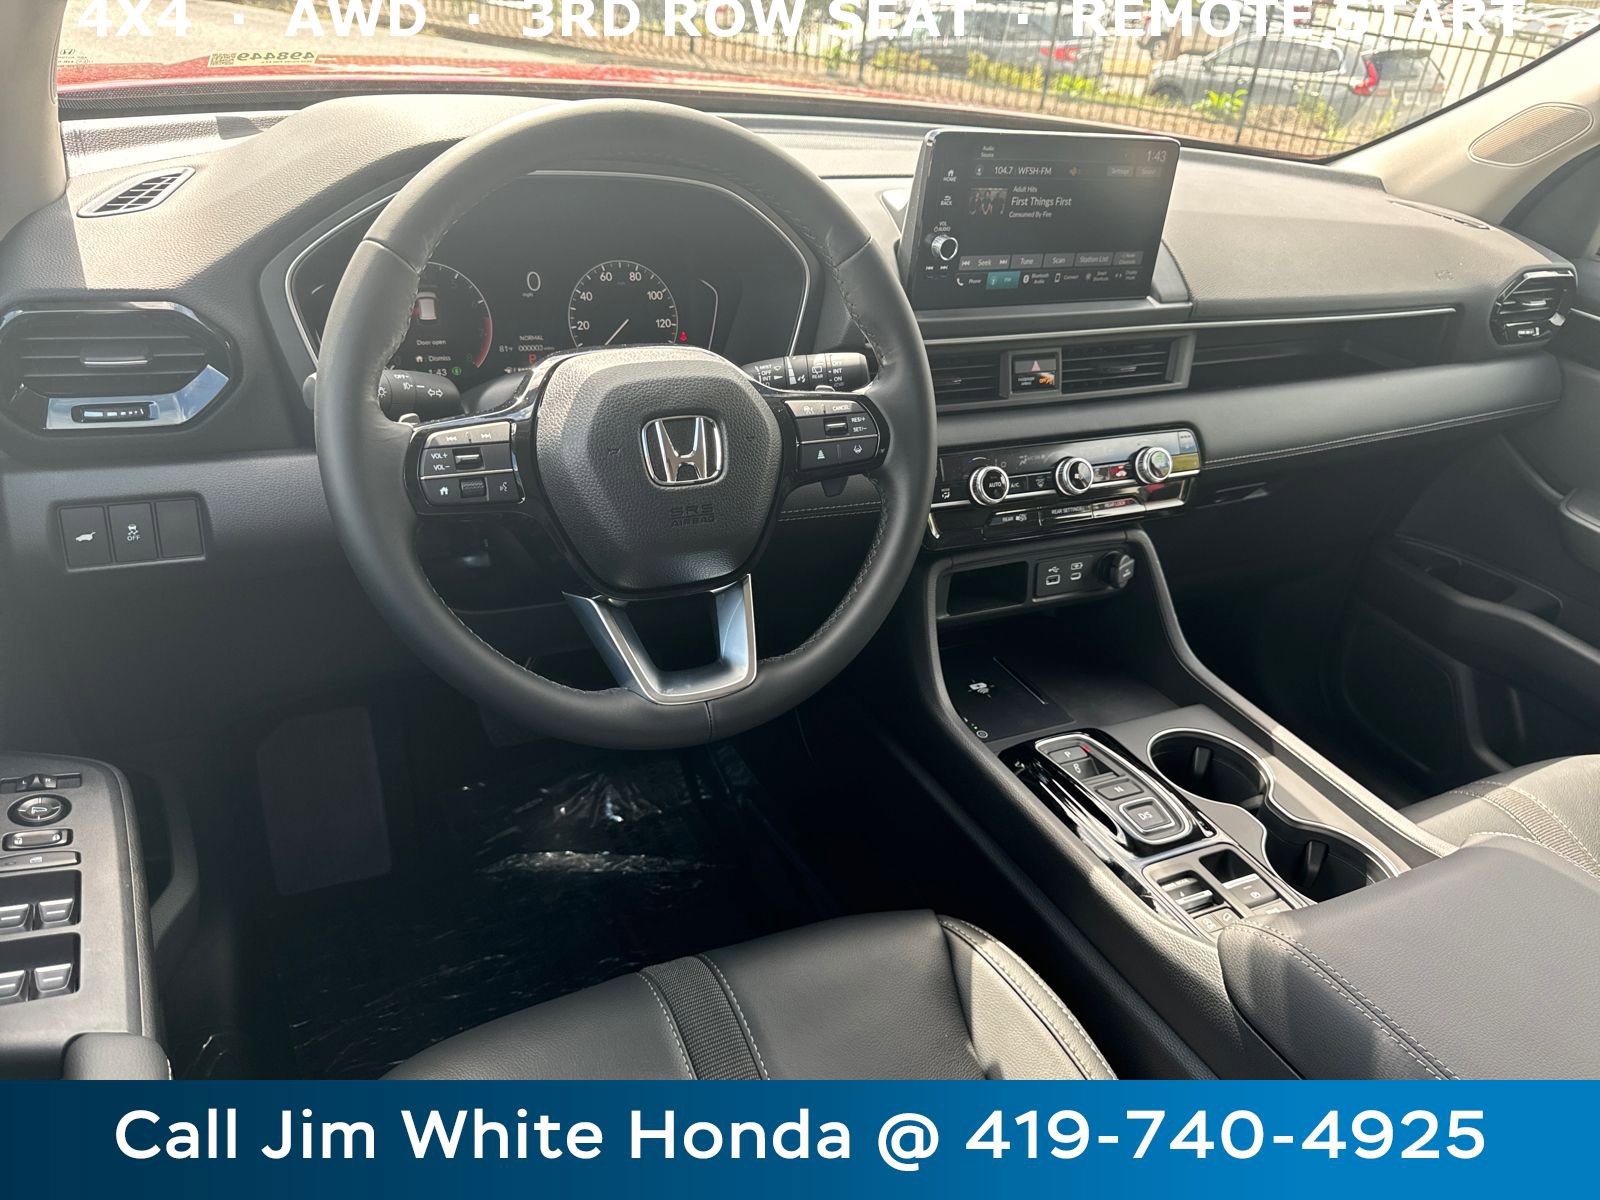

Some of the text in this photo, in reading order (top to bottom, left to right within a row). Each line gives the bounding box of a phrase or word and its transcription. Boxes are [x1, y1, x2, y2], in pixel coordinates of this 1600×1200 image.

[1147, 150, 1167, 162] 1:43
[994, 166, 1013, 175] 104.7
[1011, 196, 1073, 208] First Things First
[977, 258, 992, 267] Seek
[1052, 256, 1066, 264] Scan
[526, 271, 541, 292] 0
[599, 271, 613, 282] 60
[629, 271, 642, 282] 80
[580, 291, 593, 302] 40
[647, 290, 664, 301] 100
[577, 320, 590, 331] 20
[655, 318, 672, 328] 120
